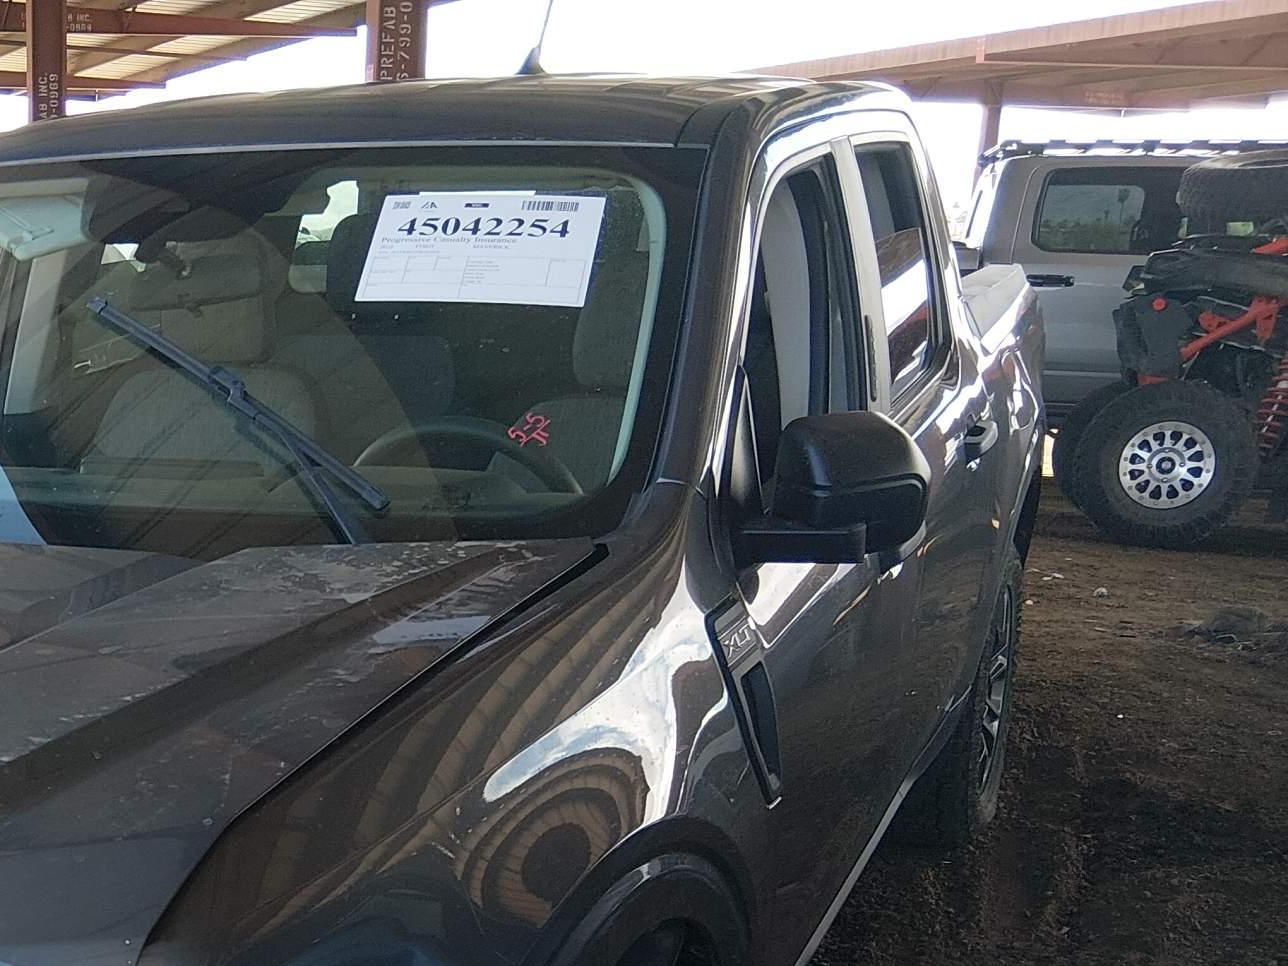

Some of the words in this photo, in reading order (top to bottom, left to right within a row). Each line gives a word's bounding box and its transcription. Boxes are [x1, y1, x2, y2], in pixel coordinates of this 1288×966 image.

[379, 7, 396, 80] PREFAB
[397, 217, 570, 238] 45042254
[723, 623, 751, 657] XLT
